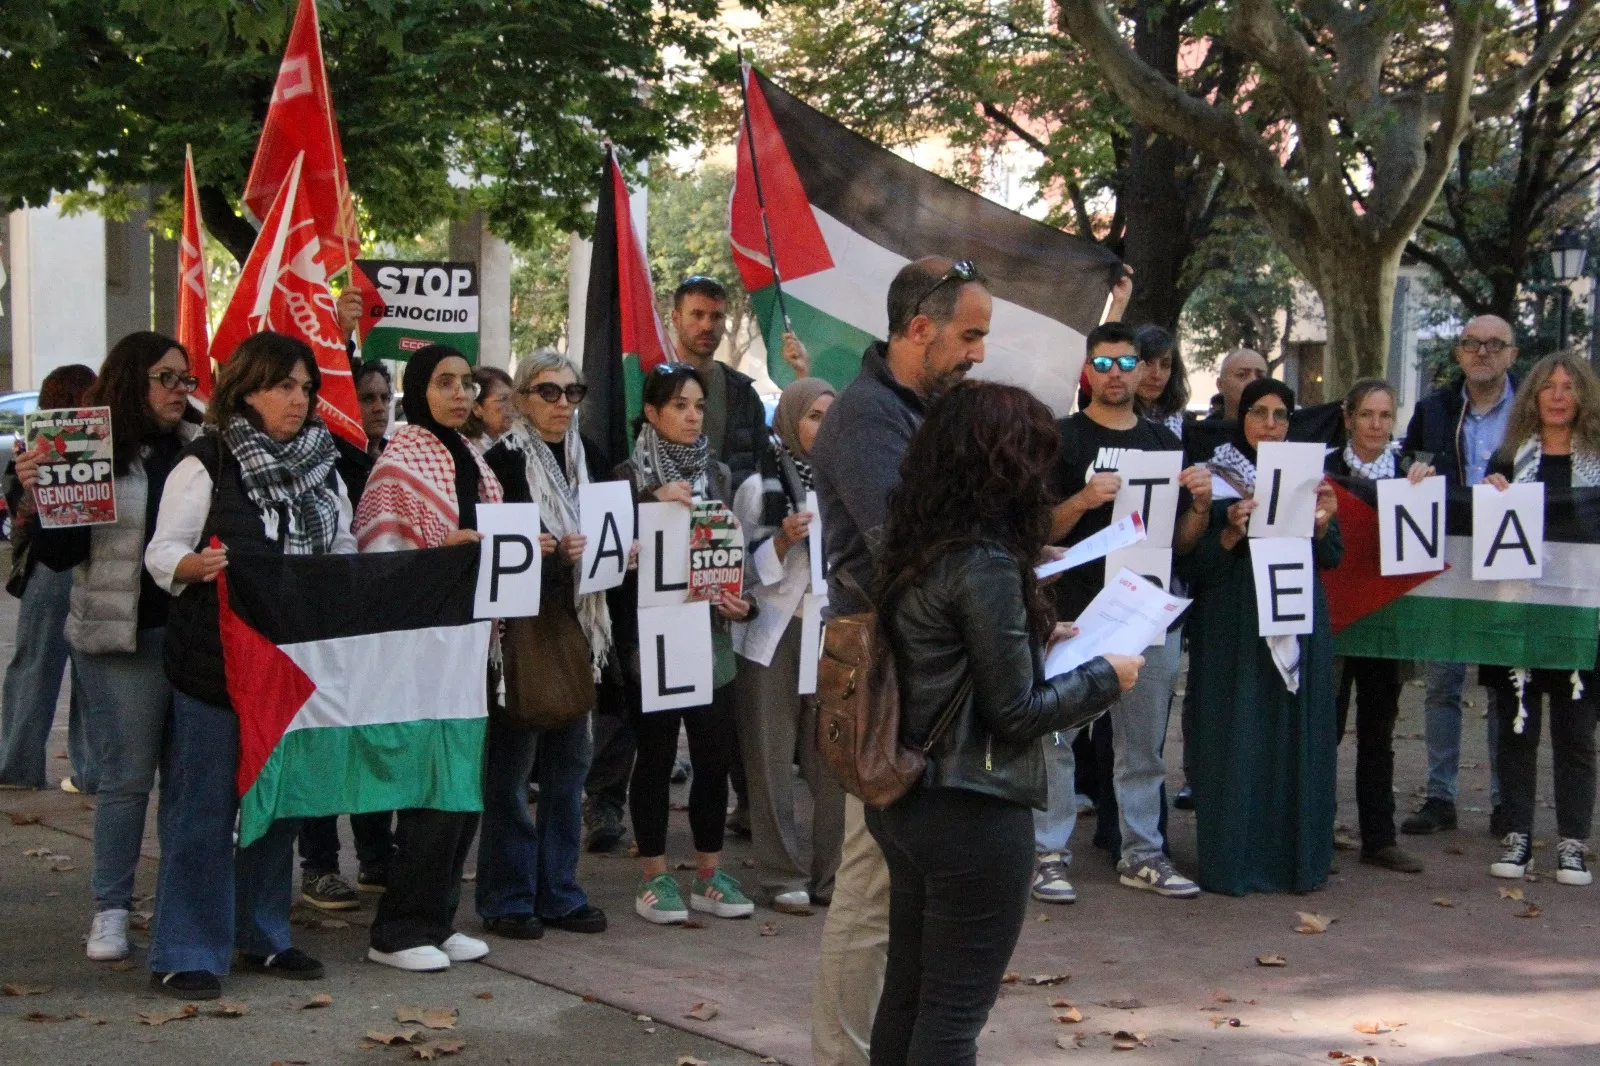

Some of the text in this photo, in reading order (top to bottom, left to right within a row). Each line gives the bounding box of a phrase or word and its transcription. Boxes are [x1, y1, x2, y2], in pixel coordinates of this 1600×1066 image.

[377, 266, 472, 297] STOP
[370, 304, 468, 323] GENOCIDIO
[55, 417, 104, 427] PALESTINE
[37, 461, 111, 486] STOP
[38, 483, 110, 505] GENOCIDIO
[1266, 469, 1281, 525] I
[1128, 478, 1170, 536] T
[1395, 502, 1438, 561] N
[589, 512, 624, 579] A
[655, 530, 689, 592] L
[692, 549, 743, 569] STOP
[1484, 510, 1536, 567] A
[490, 534, 534, 602] P
[692, 567, 740, 587] GENOCIDIO
[1268, 563, 1305, 622] E
[656, 635, 696, 697] L
